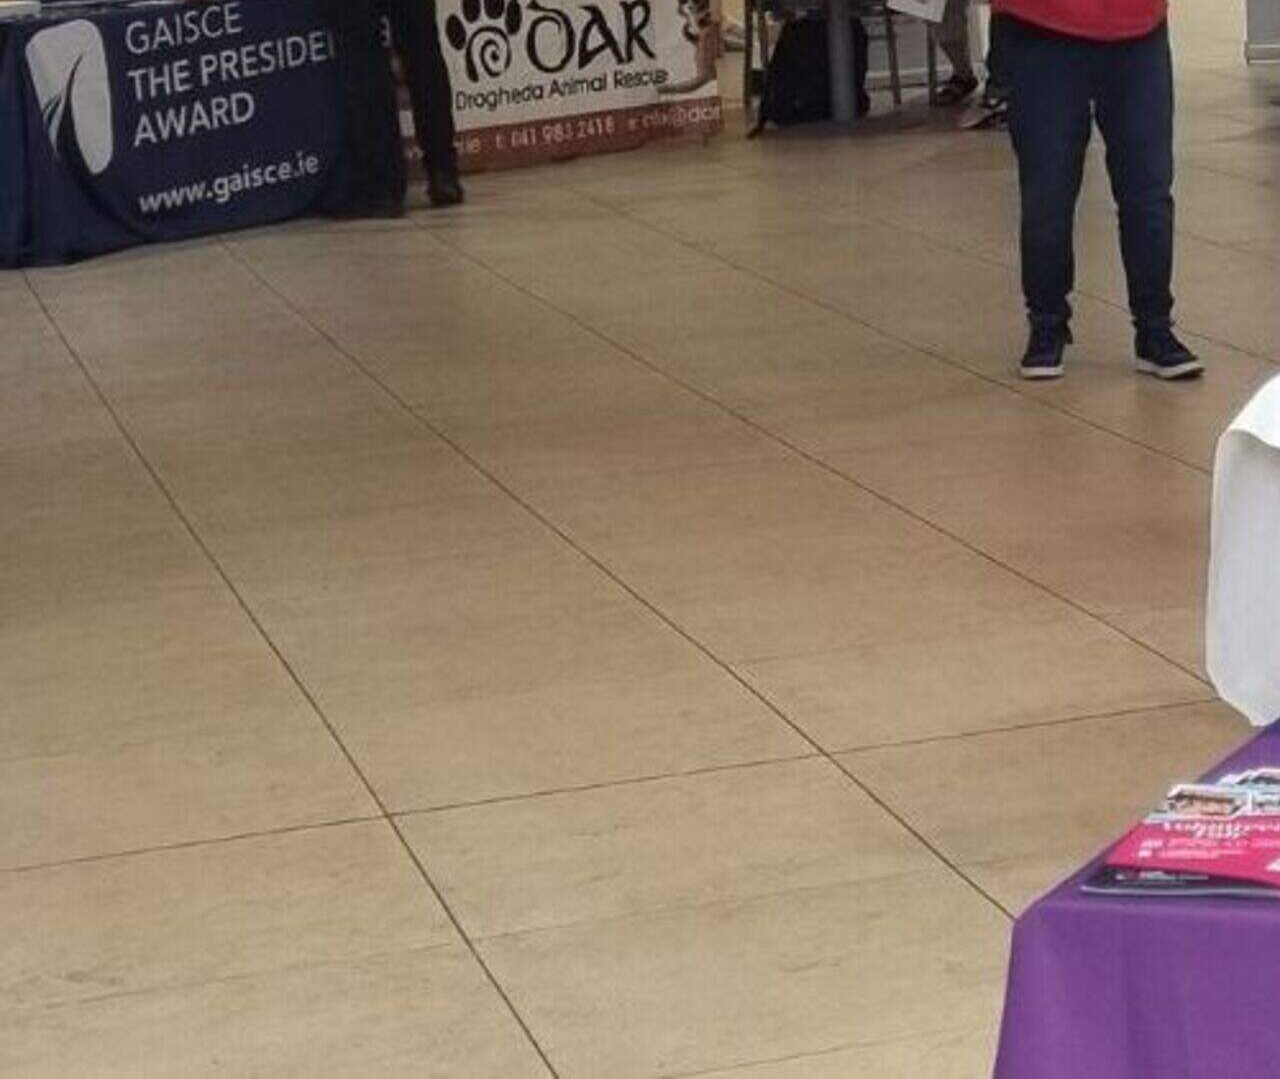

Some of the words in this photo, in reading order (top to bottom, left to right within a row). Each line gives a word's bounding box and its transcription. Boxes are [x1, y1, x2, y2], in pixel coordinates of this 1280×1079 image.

[125, 1, 243, 55] GAISCE
[127, 59, 192, 101] THE
[455, 84, 545, 111] Drogheda
[551, 72, 608, 99] Animal
[613, 68, 669, 89] Rescue
[133, 92, 255, 148] AWARD
[138, 151, 320, 213] www.gaisce.ie
